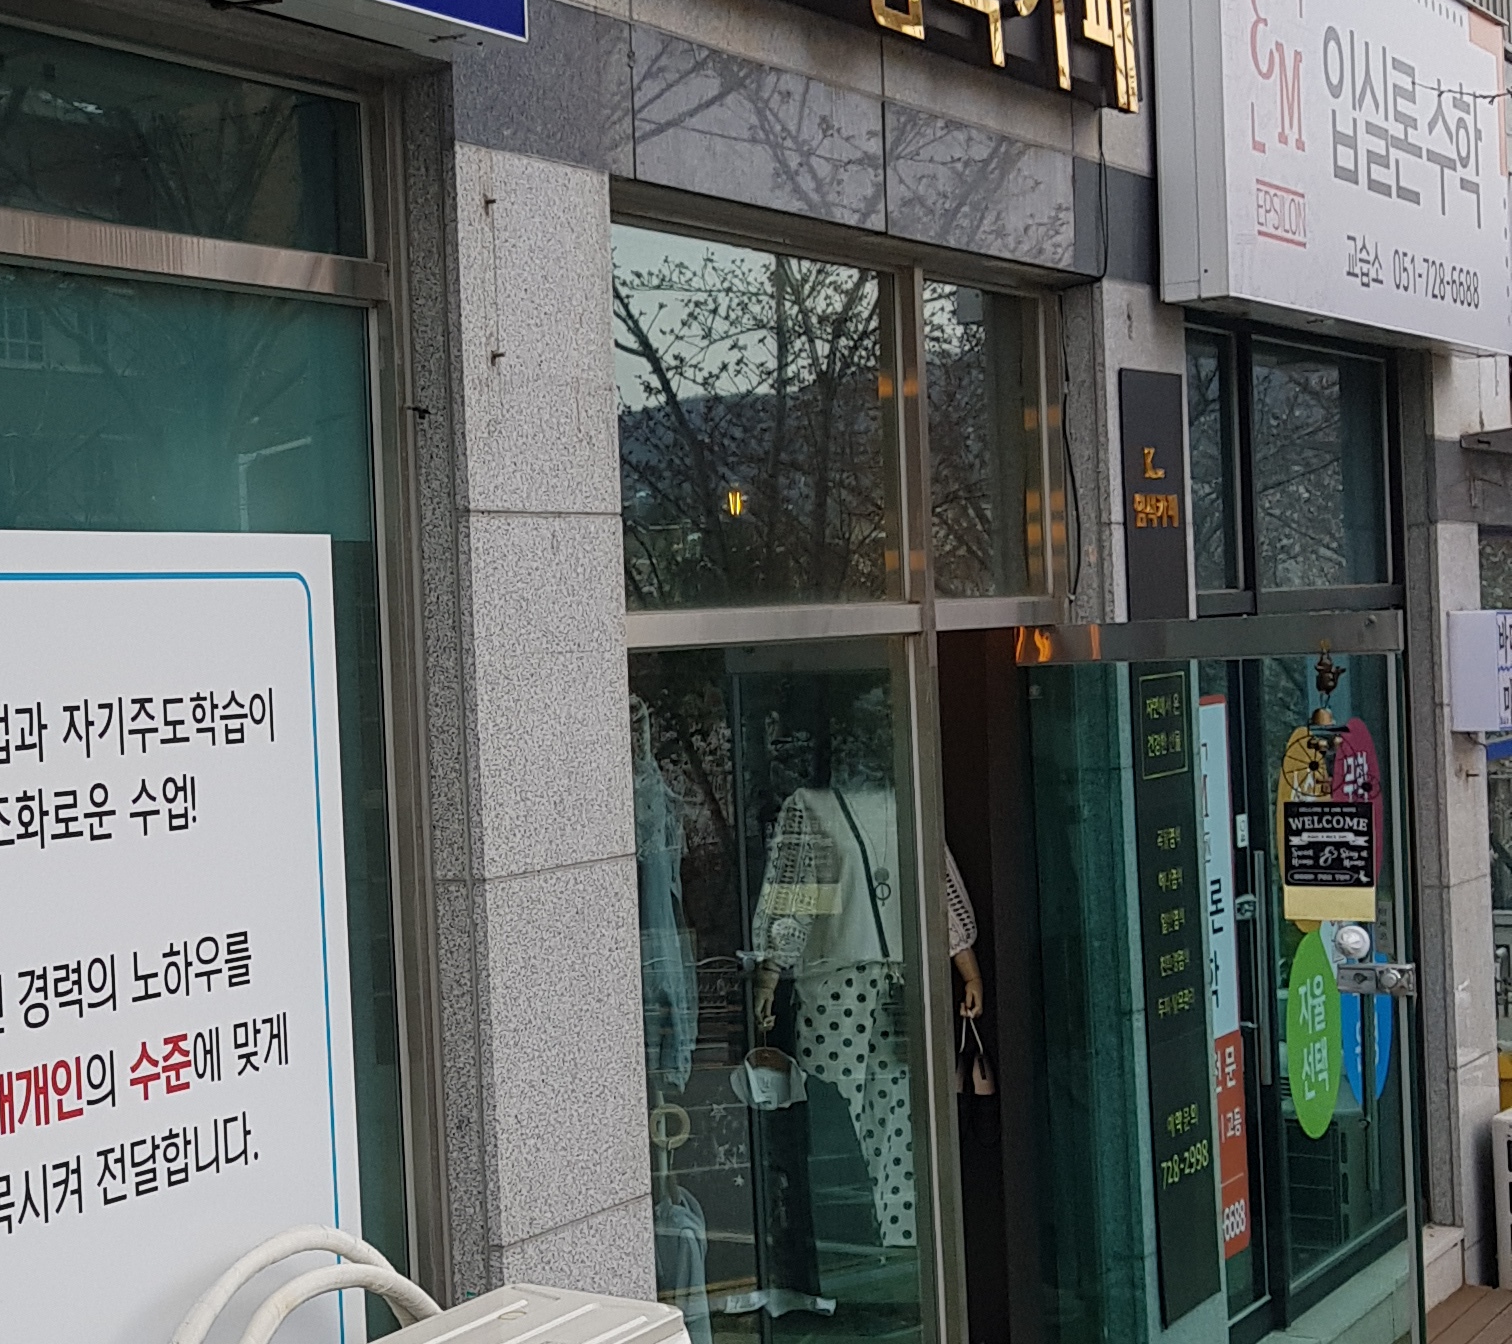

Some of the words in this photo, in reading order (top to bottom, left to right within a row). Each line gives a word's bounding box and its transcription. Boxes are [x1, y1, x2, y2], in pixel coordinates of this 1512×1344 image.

[1322, 24, 1483, 230] 입실론수학
[1256, 187, 1307, 239] EPSILON
[1345, 234, 1384, 289] 교습소
[1392, 248, 1481, 310] 051-728-6688
[61, 686, 276, 758] 자기주도학습이
[128, 774, 199, 836] 수업!
[1288, 815, 1369, 832] WELCOME
[17, 953, 118, 1030] 경력의
[131, 929, 253, 1004] 노하우를
[1297, 974, 1326, 1034] 자율
[128, 1025, 222, 1104] 수준에
[231, 1011, 290, 1077] 맞게
[1301, 1036, 1329, 1101] 선택
[94, 1110, 260, 1208] 전달합니다.
[1160, 1139, 1210, 1190] 728-2998
